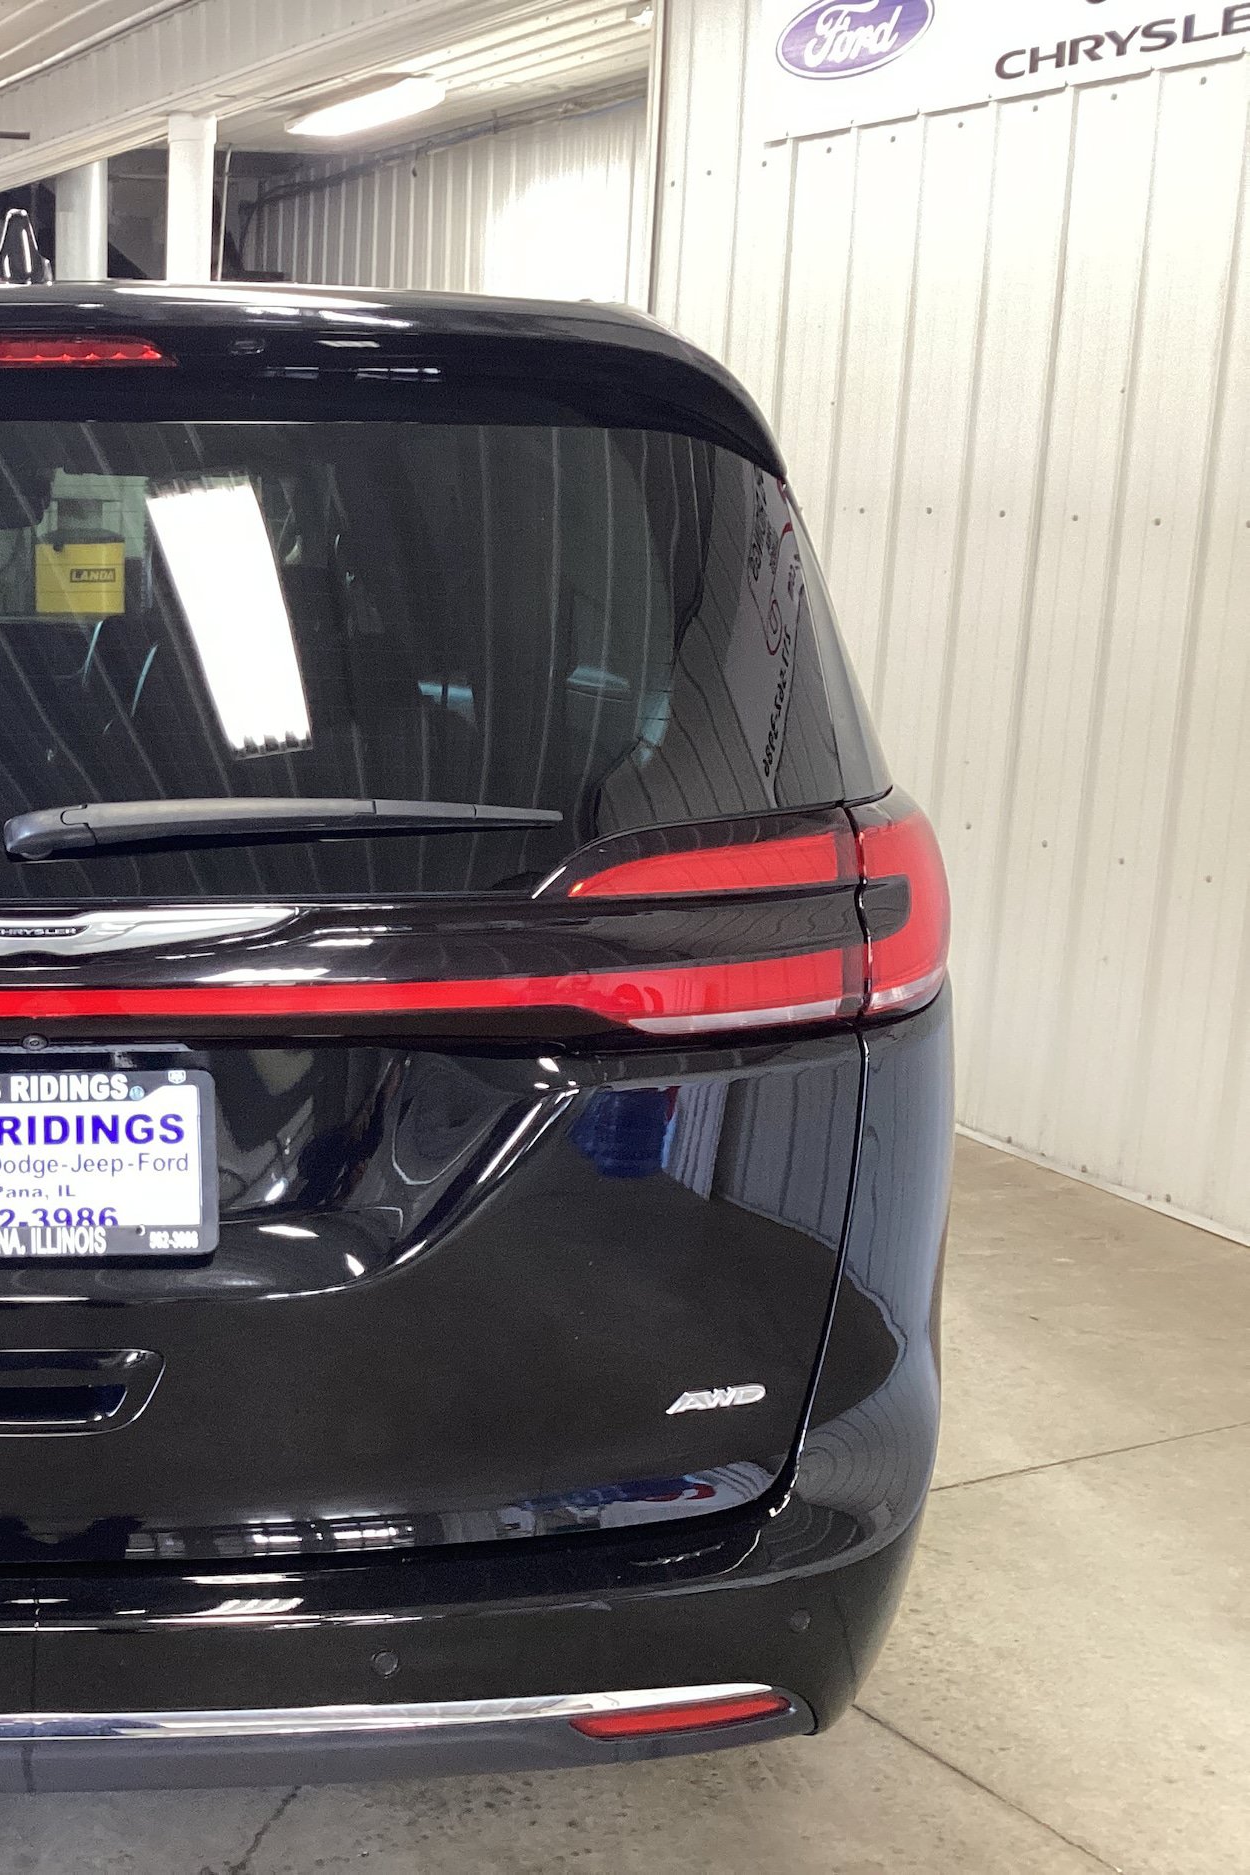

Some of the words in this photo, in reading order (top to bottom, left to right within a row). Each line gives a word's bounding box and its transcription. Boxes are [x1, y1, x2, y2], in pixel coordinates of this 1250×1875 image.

[803, 0, 900, 69] Ford
[71, 570, 114, 581] LANDA
[10, 1073, 129, 1102] RIDINGS
[58, 1185, 76, 1198] IL
[30, 1226, 107, 1255] ILLINOIS
[665, 1383, 767, 1415] AWD
